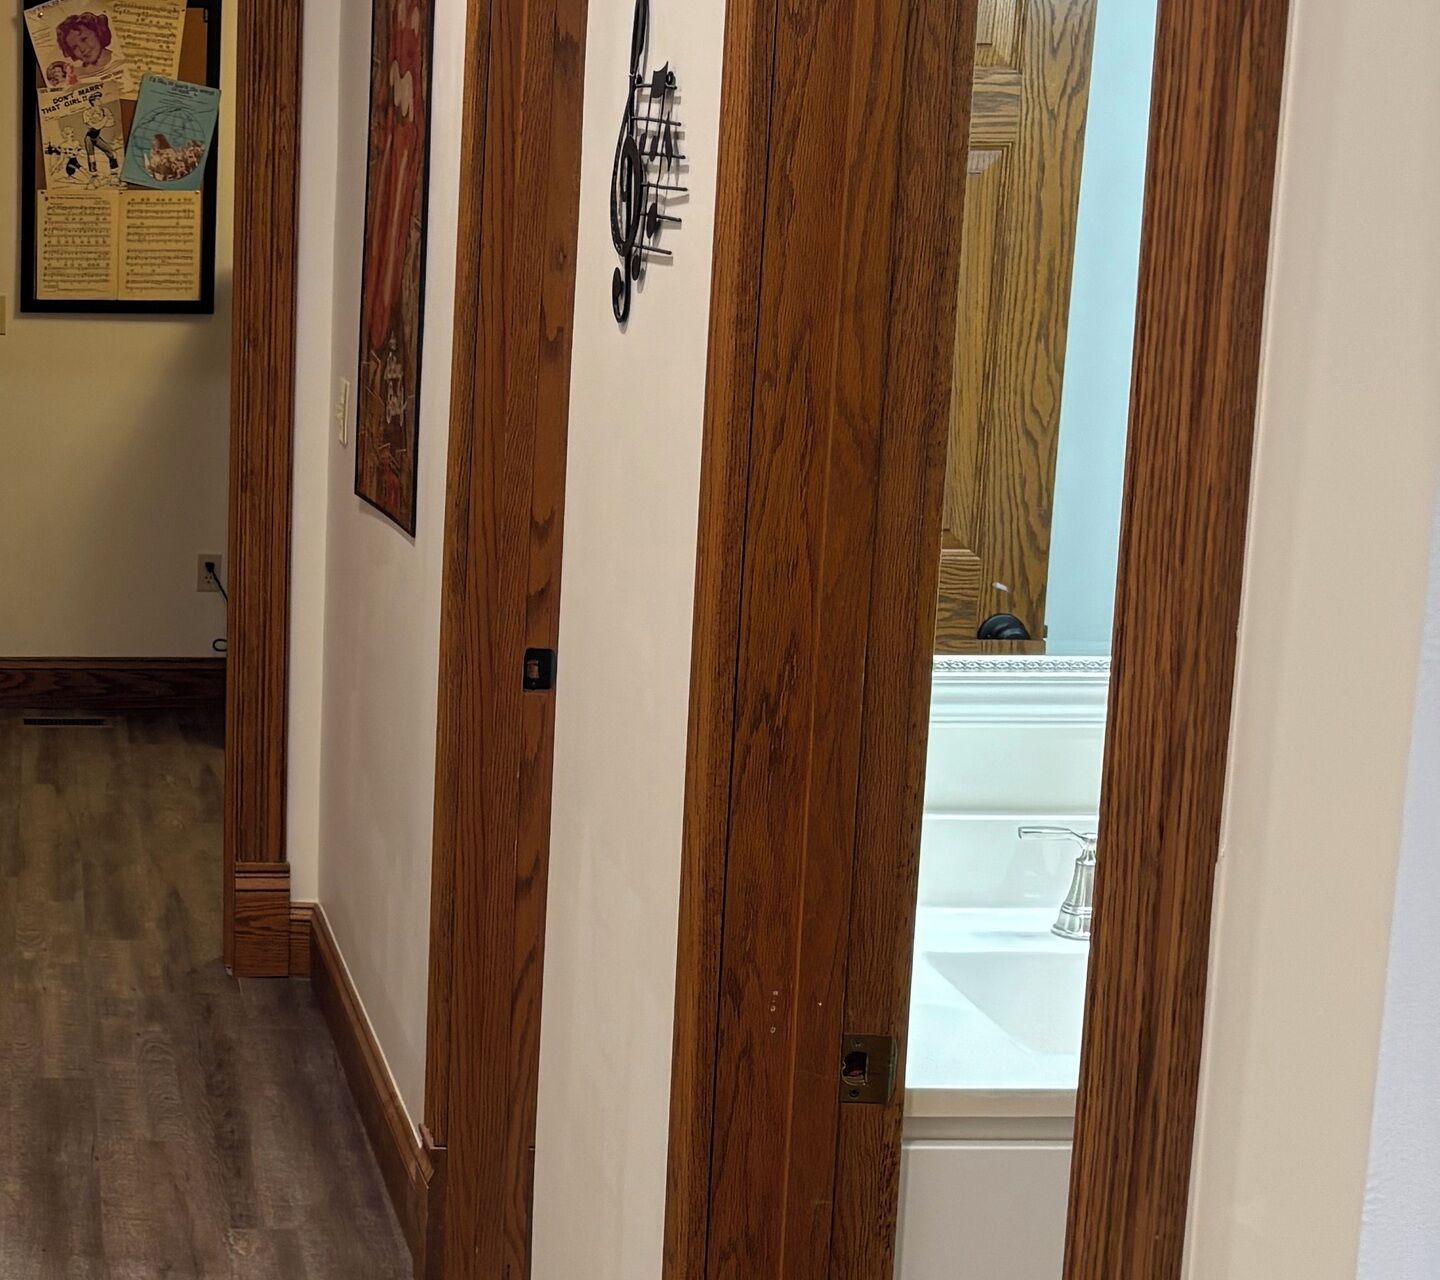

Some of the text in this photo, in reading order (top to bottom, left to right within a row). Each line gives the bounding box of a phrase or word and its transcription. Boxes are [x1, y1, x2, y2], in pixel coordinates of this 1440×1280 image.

[53, 92, 74, 104] DON'T
[77, 83, 104, 95] MARRY
[41, 104, 61, 114] THAT
